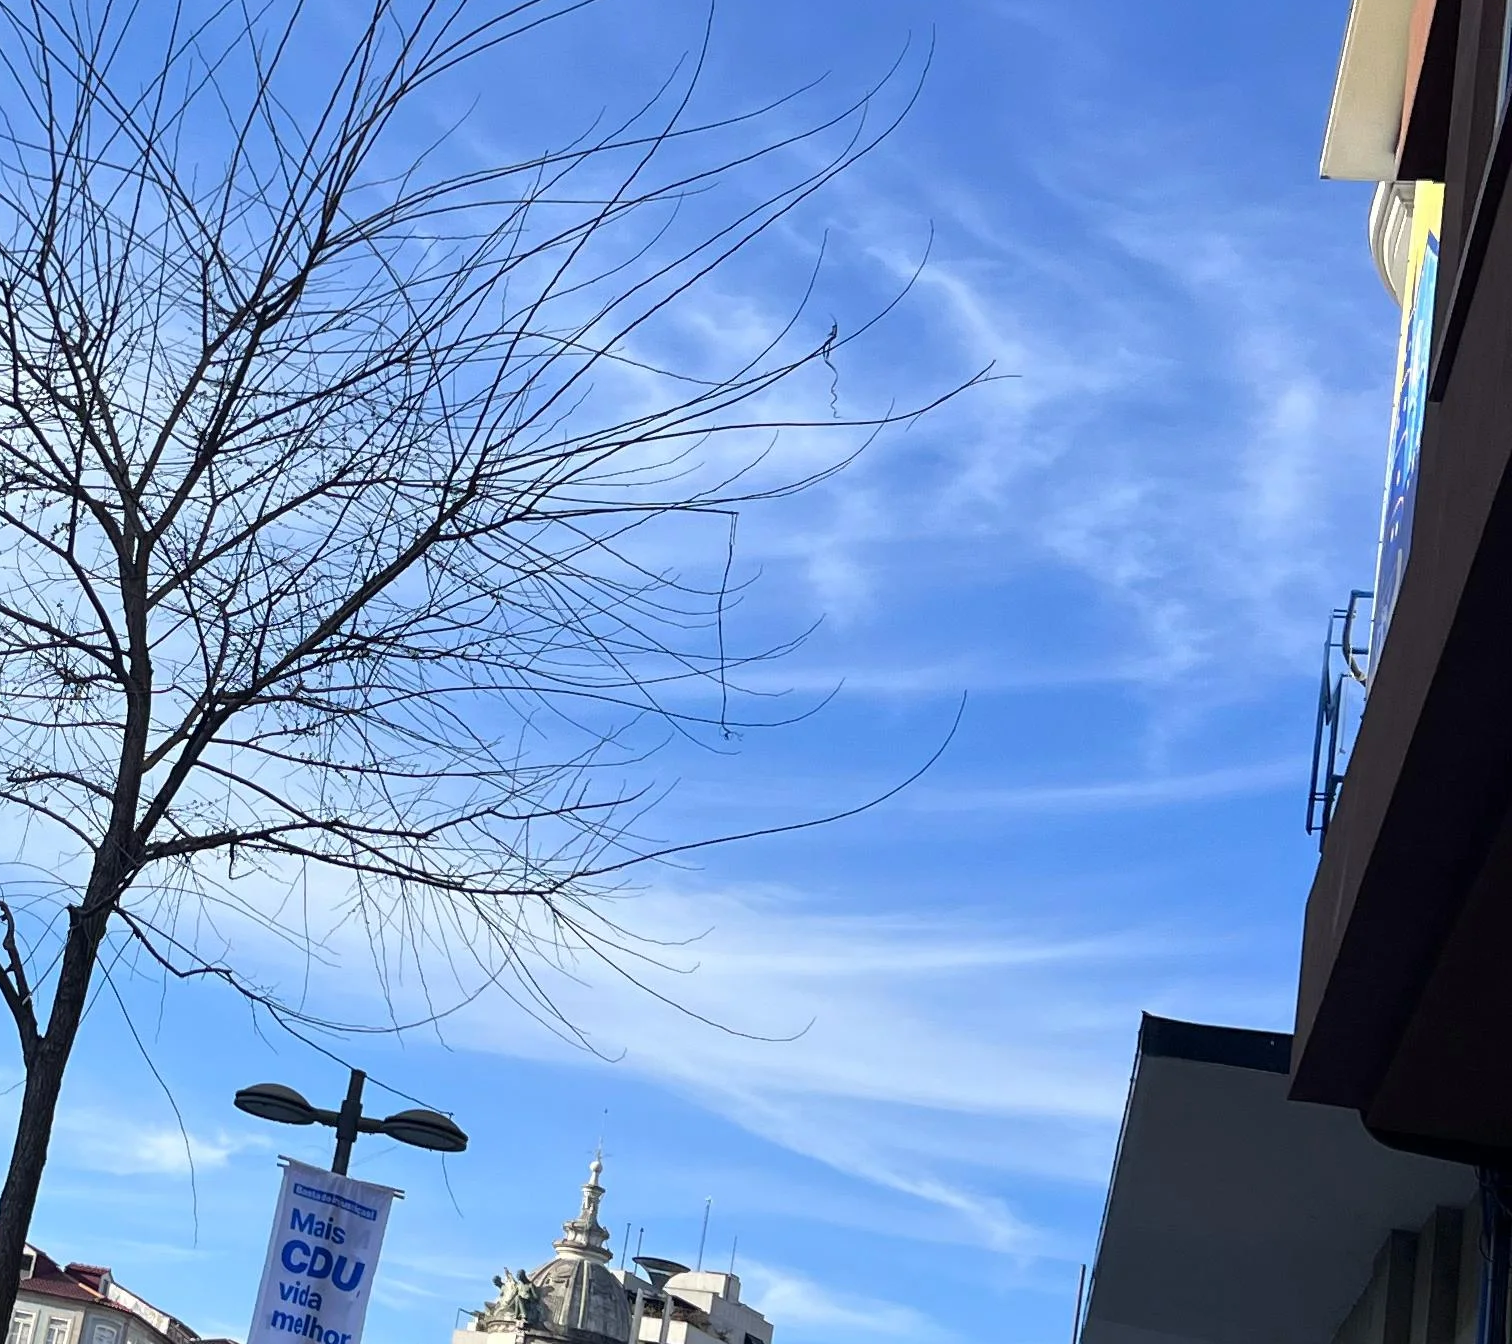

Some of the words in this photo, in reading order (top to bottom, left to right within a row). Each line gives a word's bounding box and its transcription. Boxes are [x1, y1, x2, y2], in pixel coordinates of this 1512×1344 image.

[289, 1207, 345, 1245] Mais
[281, 1239, 365, 1292] CDU
[279, 1280, 323, 1312] vida
